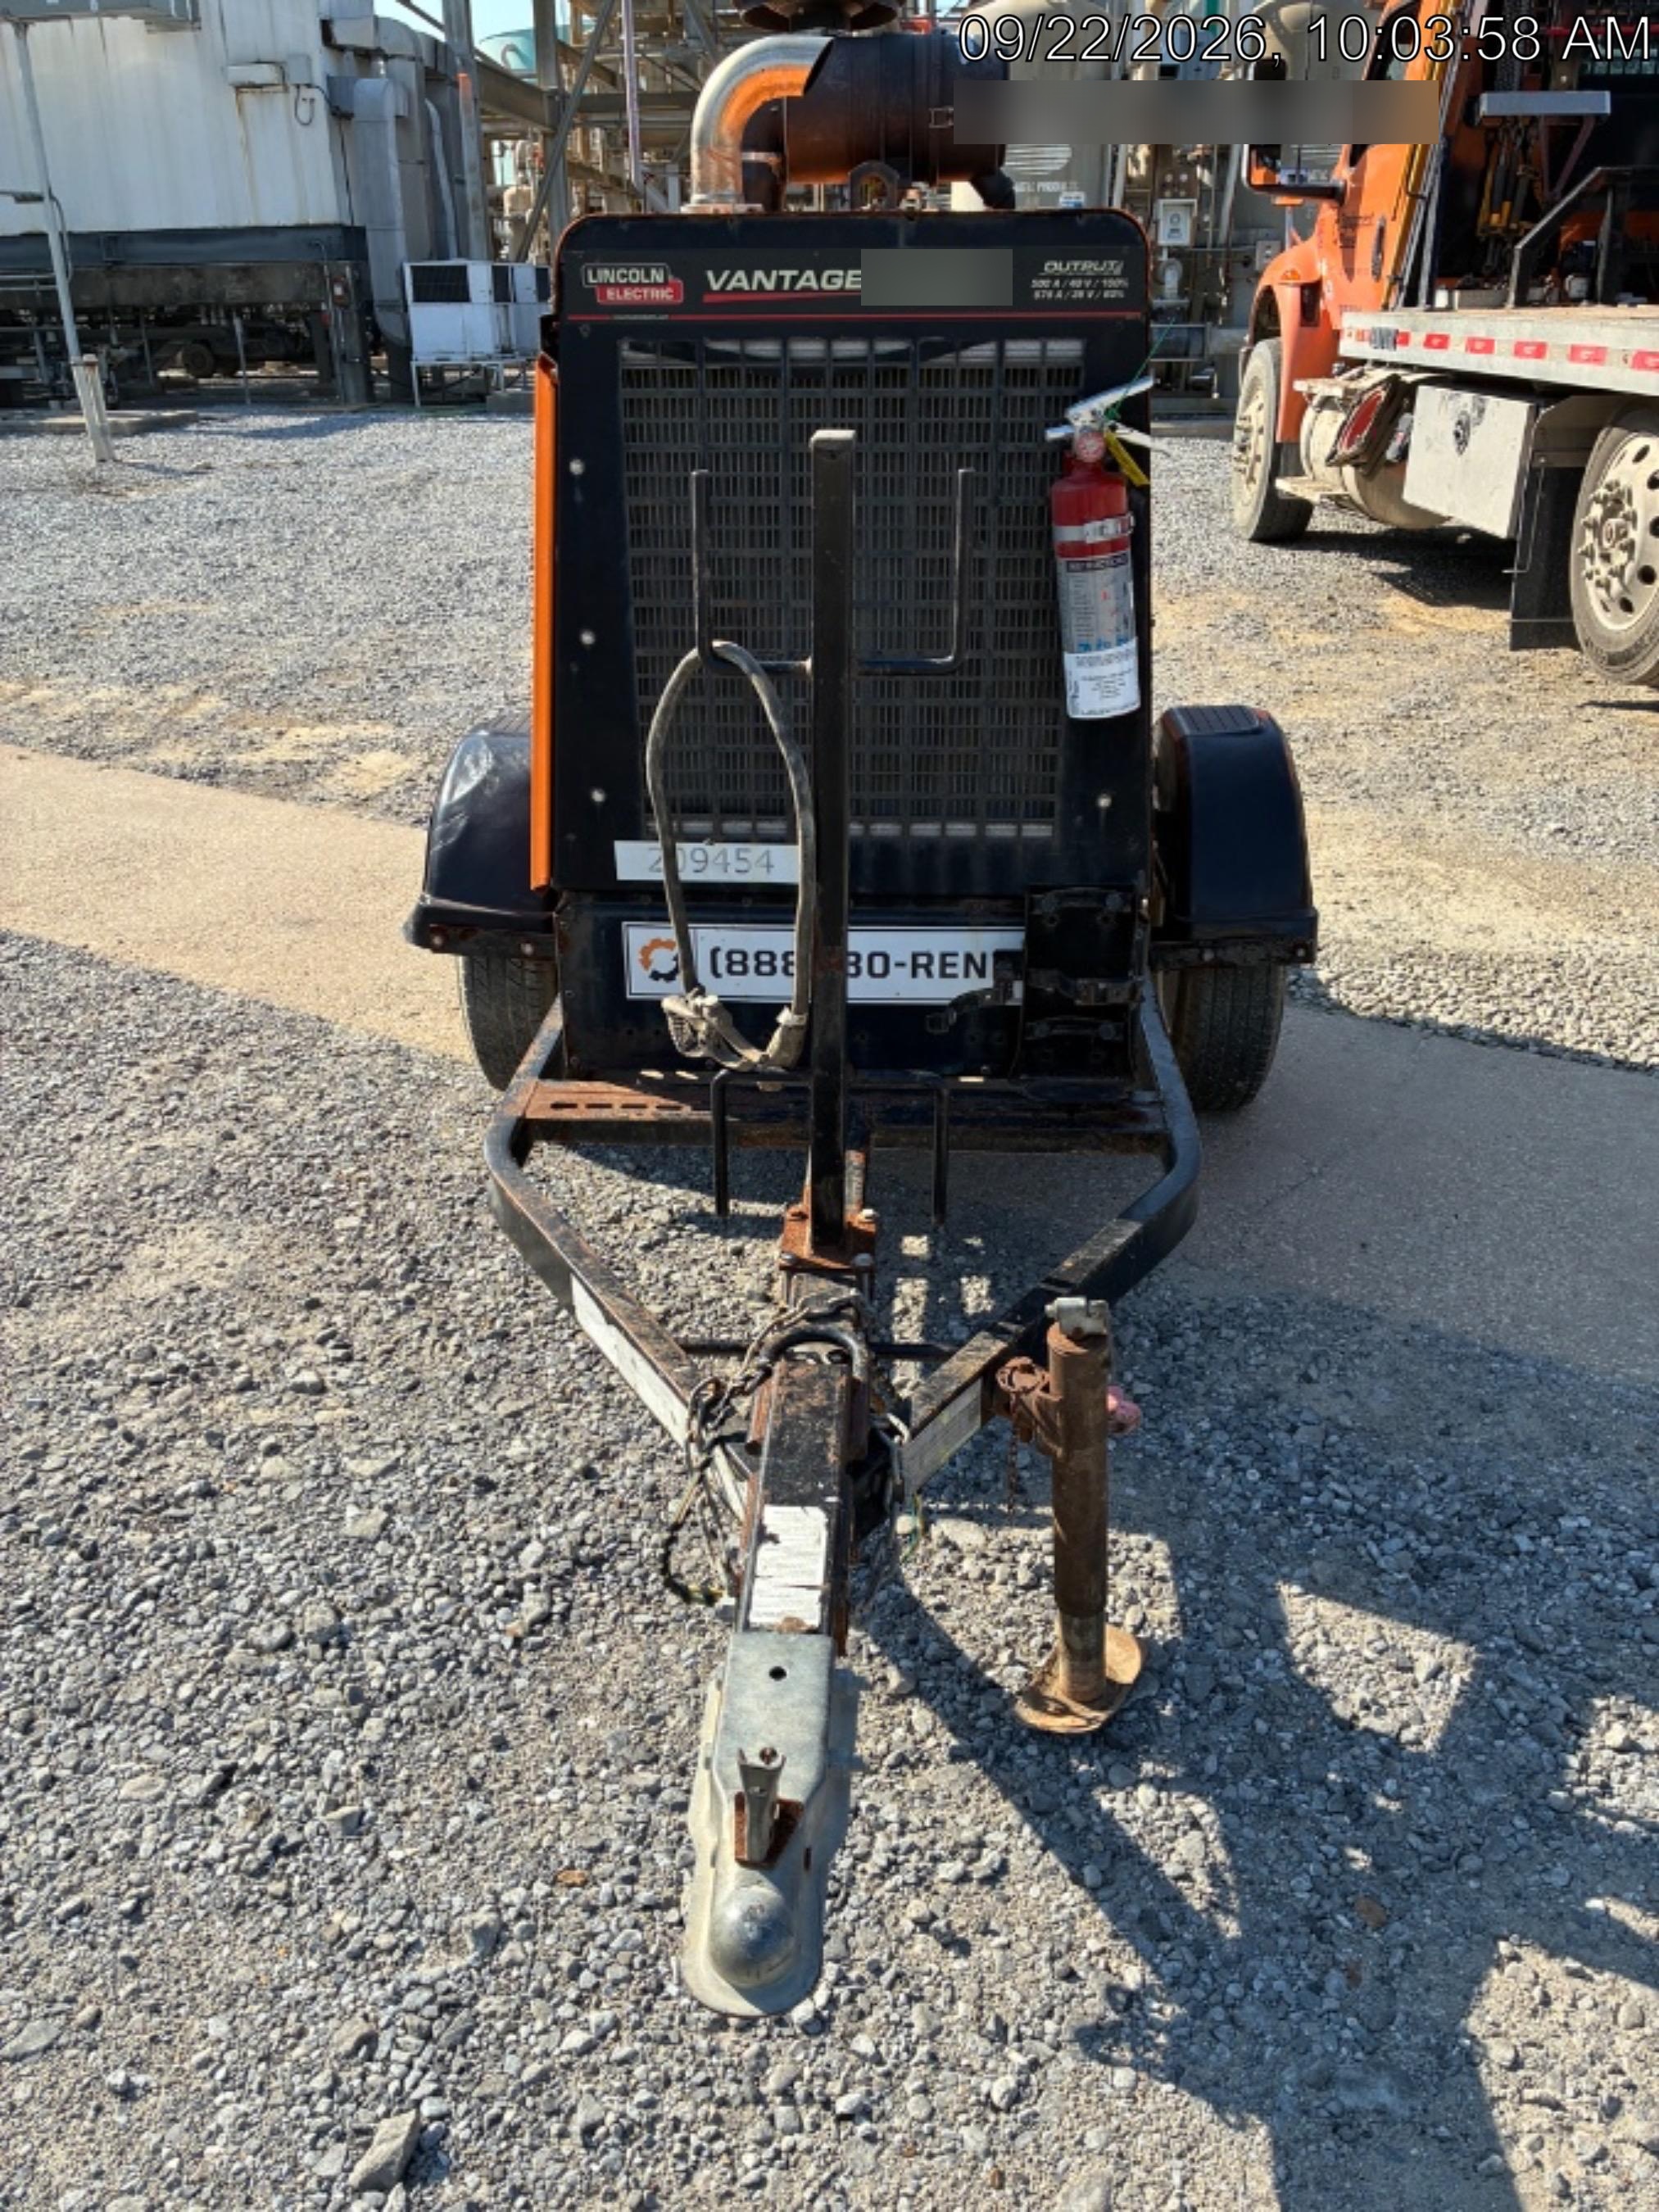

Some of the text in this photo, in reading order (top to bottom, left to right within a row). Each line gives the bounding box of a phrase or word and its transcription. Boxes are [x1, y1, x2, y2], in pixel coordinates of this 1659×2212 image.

[1044, 260, 1121, 273] OUTPUT
[587, 268, 665, 284] LINCOLN
[705, 270, 862, 291] VANTAGE
[606, 287, 674, 301] ELECTRIC
[647, 846, 774, 874] 209454
